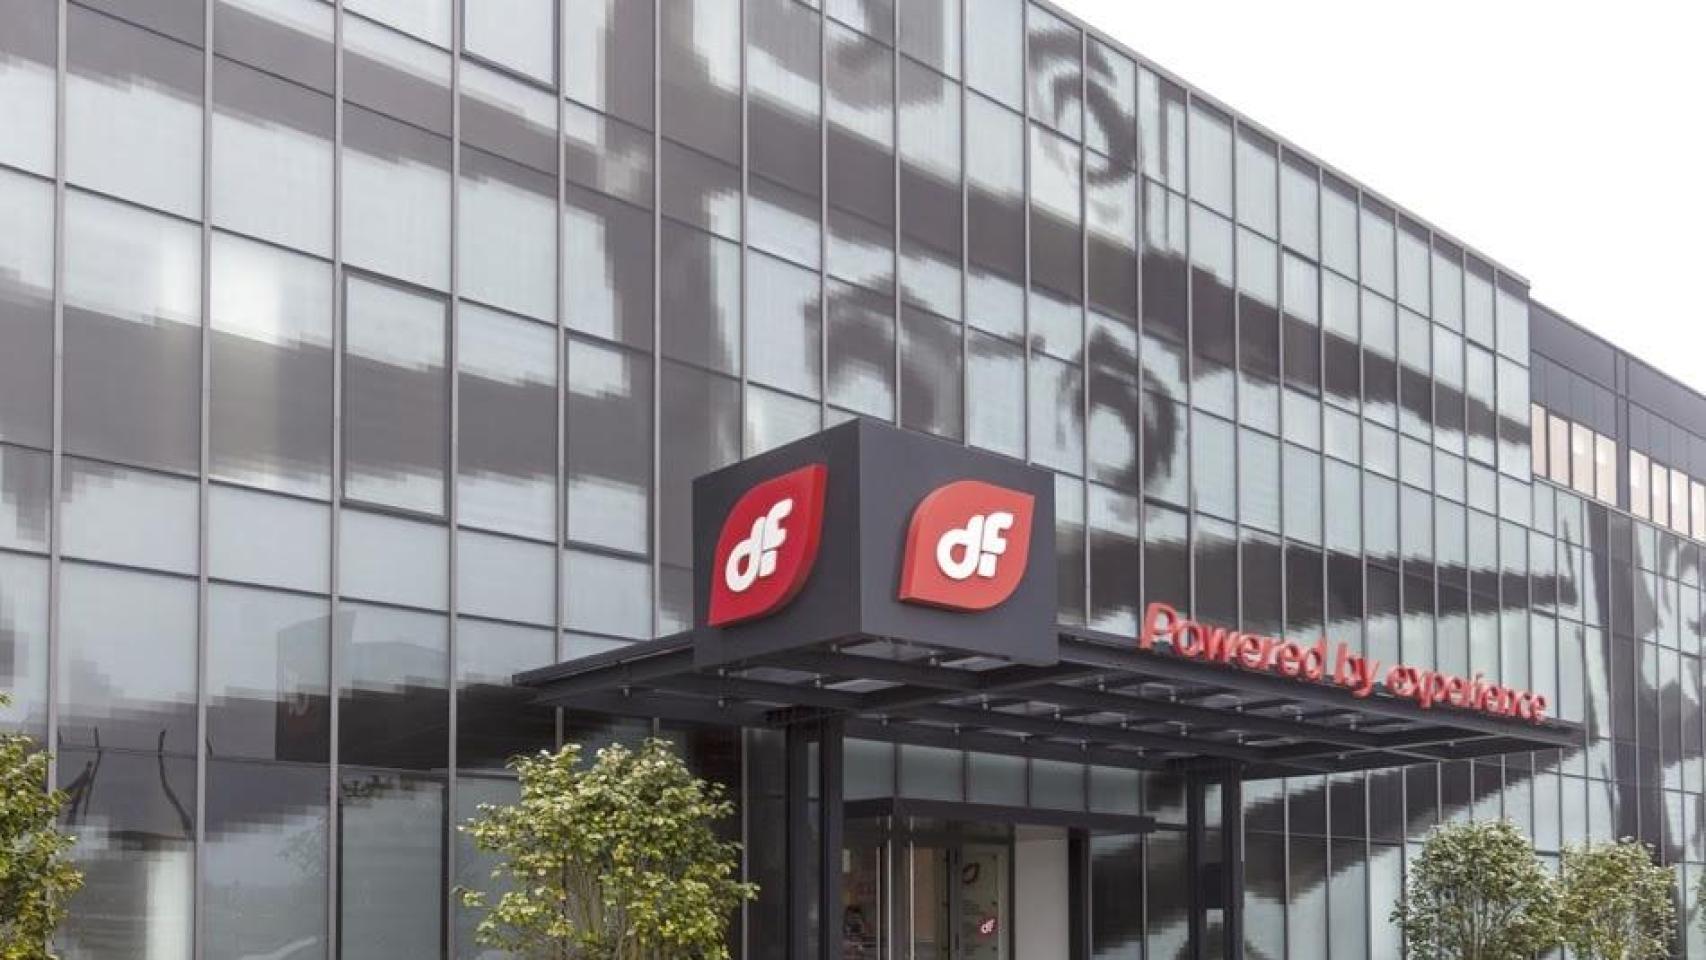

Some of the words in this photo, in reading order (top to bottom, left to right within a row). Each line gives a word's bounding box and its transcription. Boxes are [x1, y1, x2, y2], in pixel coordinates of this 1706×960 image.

[1140, 602, 1327, 682] Powered
[1333, 642, 1380, 697] by
[1385, 662, 1548, 724] experience
